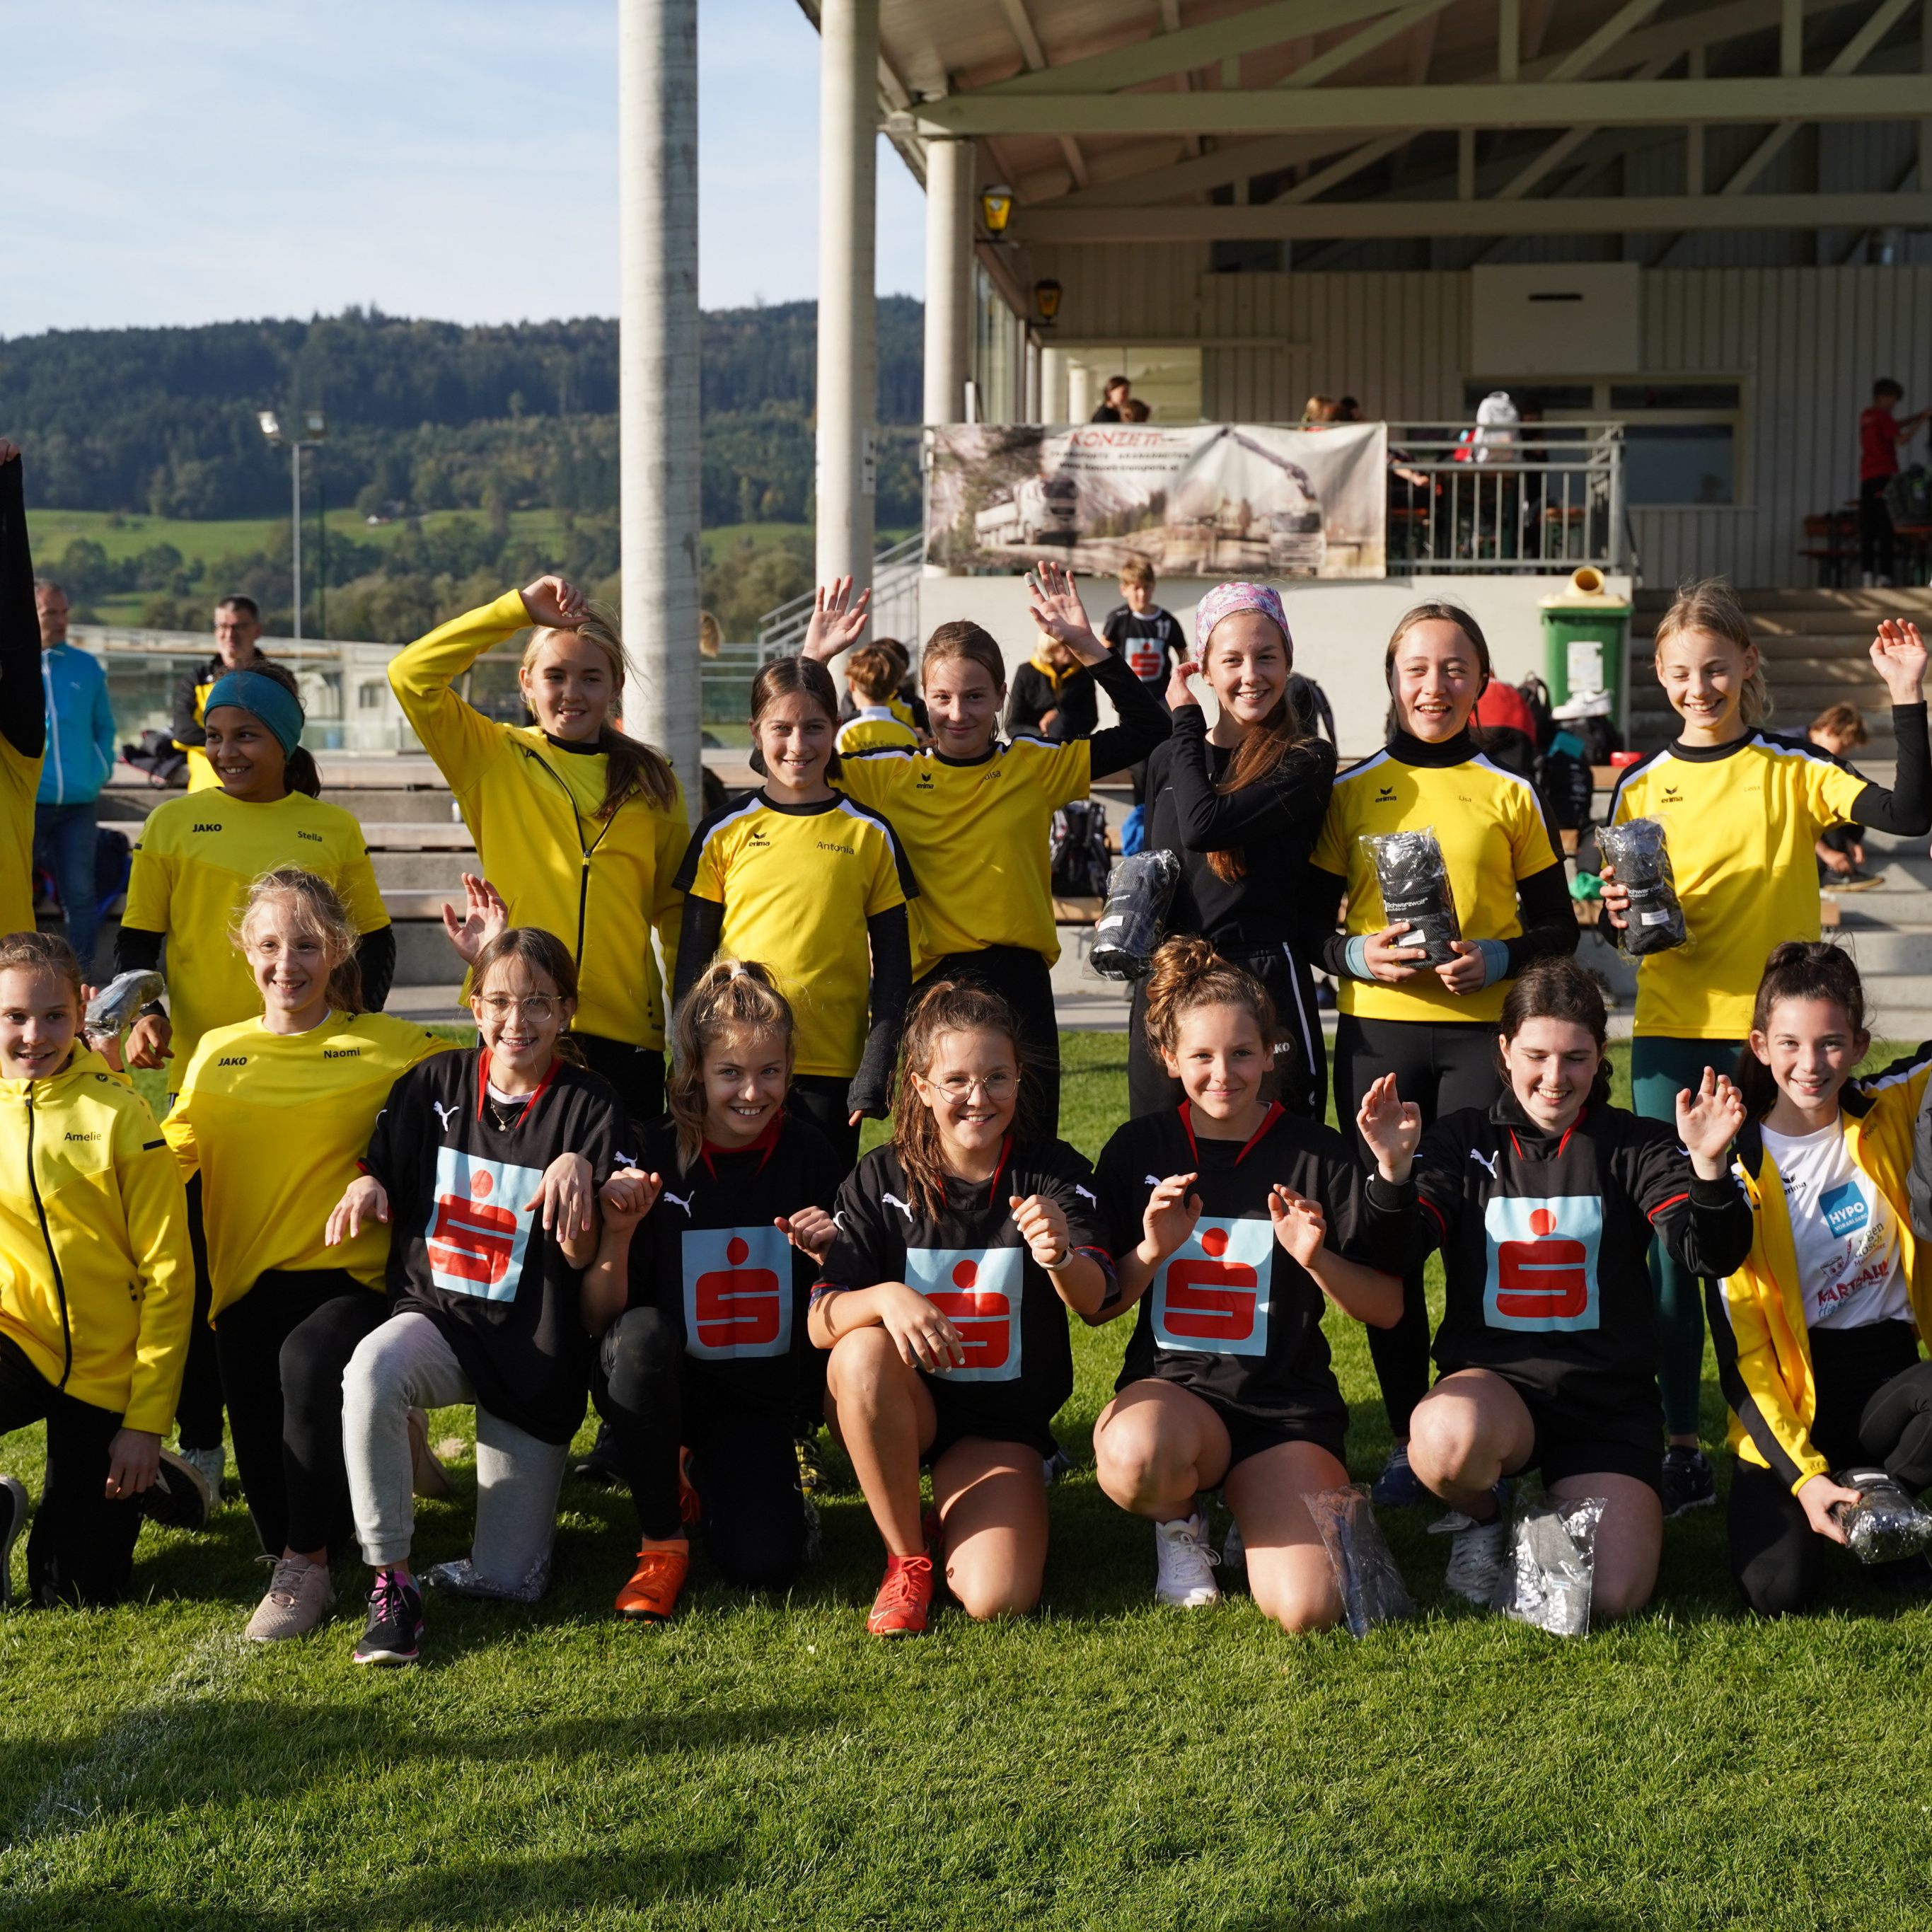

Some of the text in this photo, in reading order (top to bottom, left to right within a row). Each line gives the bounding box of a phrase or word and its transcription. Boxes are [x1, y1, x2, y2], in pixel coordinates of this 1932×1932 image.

[984, 770, 1001, 780] uisa
[1375, 794, 1396, 803] erima
[192, 823, 222, 833] JAKO
[297, 831, 323, 842] Stella
[816, 840, 854, 855] Antonia
[323, 1047, 360, 1059] Naomi
[218, 1056, 247, 1067] JAKO
[64, 1131, 101, 1141] Amelie
[1829, 1202, 1864, 1225] HYPO
